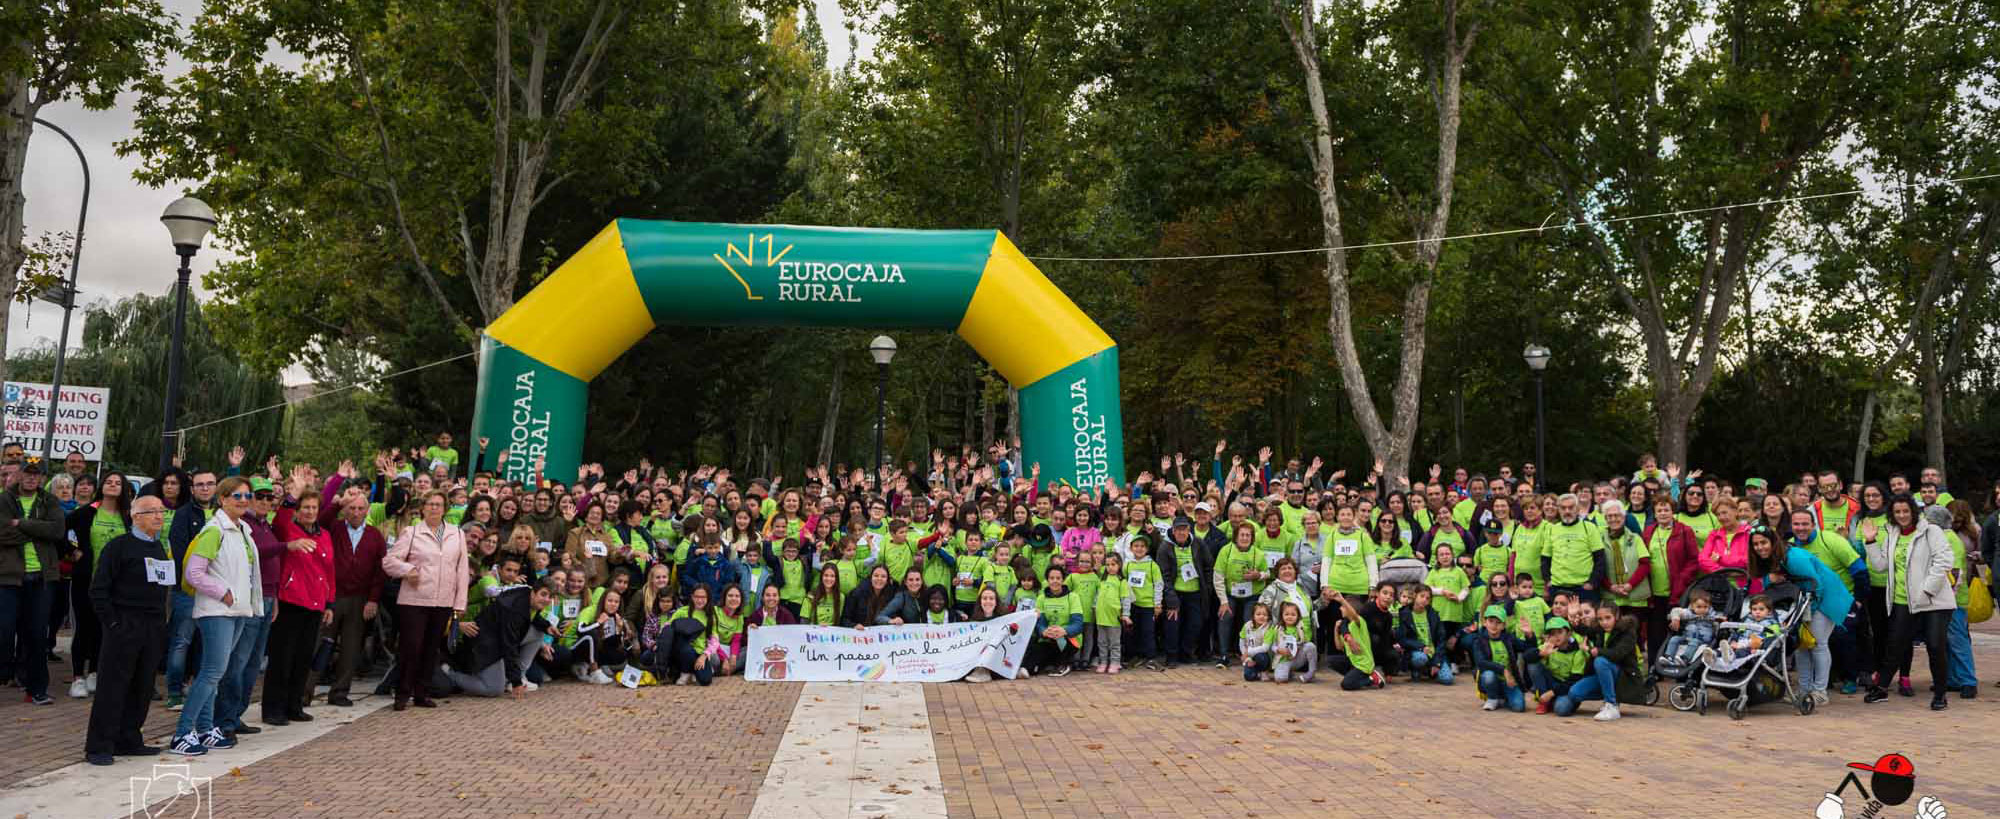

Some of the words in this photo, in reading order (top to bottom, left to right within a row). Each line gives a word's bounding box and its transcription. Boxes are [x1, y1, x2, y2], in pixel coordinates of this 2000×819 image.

[778, 262, 906, 283] EUROCAJA
[778, 283, 862, 302] RURAL
[5, 404, 98, 420] RESEVADO
[6, 419, 95, 436] RESTARANTE
[507, 370, 535, 482] EUROCAJA
[1070, 377, 1093, 488] EUROCAJA
[1091, 414, 1109, 487] RURAL
[834, 654, 880, 670] paseo
[888, 650, 917, 665] por
[922, 641, 941, 654] la
